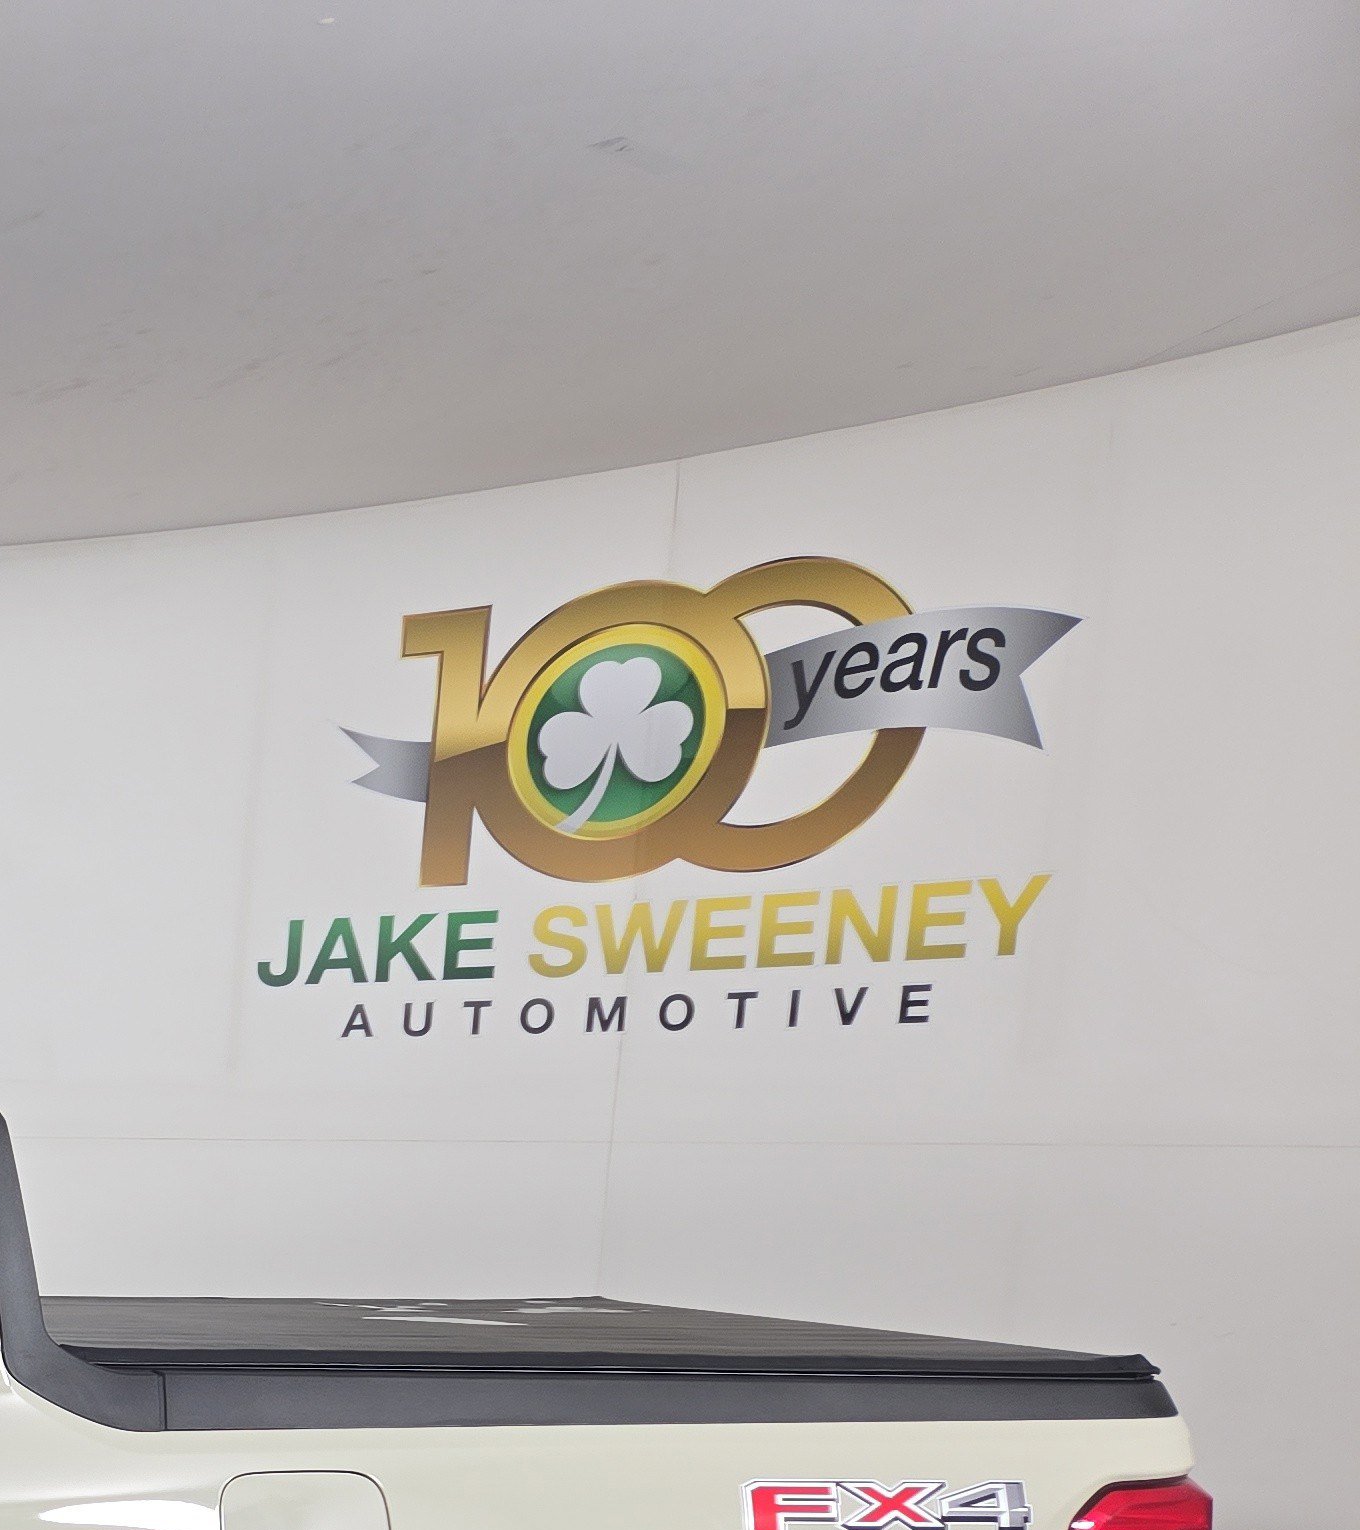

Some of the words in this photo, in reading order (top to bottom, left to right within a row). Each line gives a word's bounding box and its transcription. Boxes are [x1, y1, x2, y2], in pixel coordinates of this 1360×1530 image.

[401, 556, 926, 888] 100
[784, 626, 1007, 730] years
[256, 909, 499, 988] JAKE
[527, 873, 1051, 977] SWEENEY
[342, 984, 933, 1038] AUTOMOTIVE
